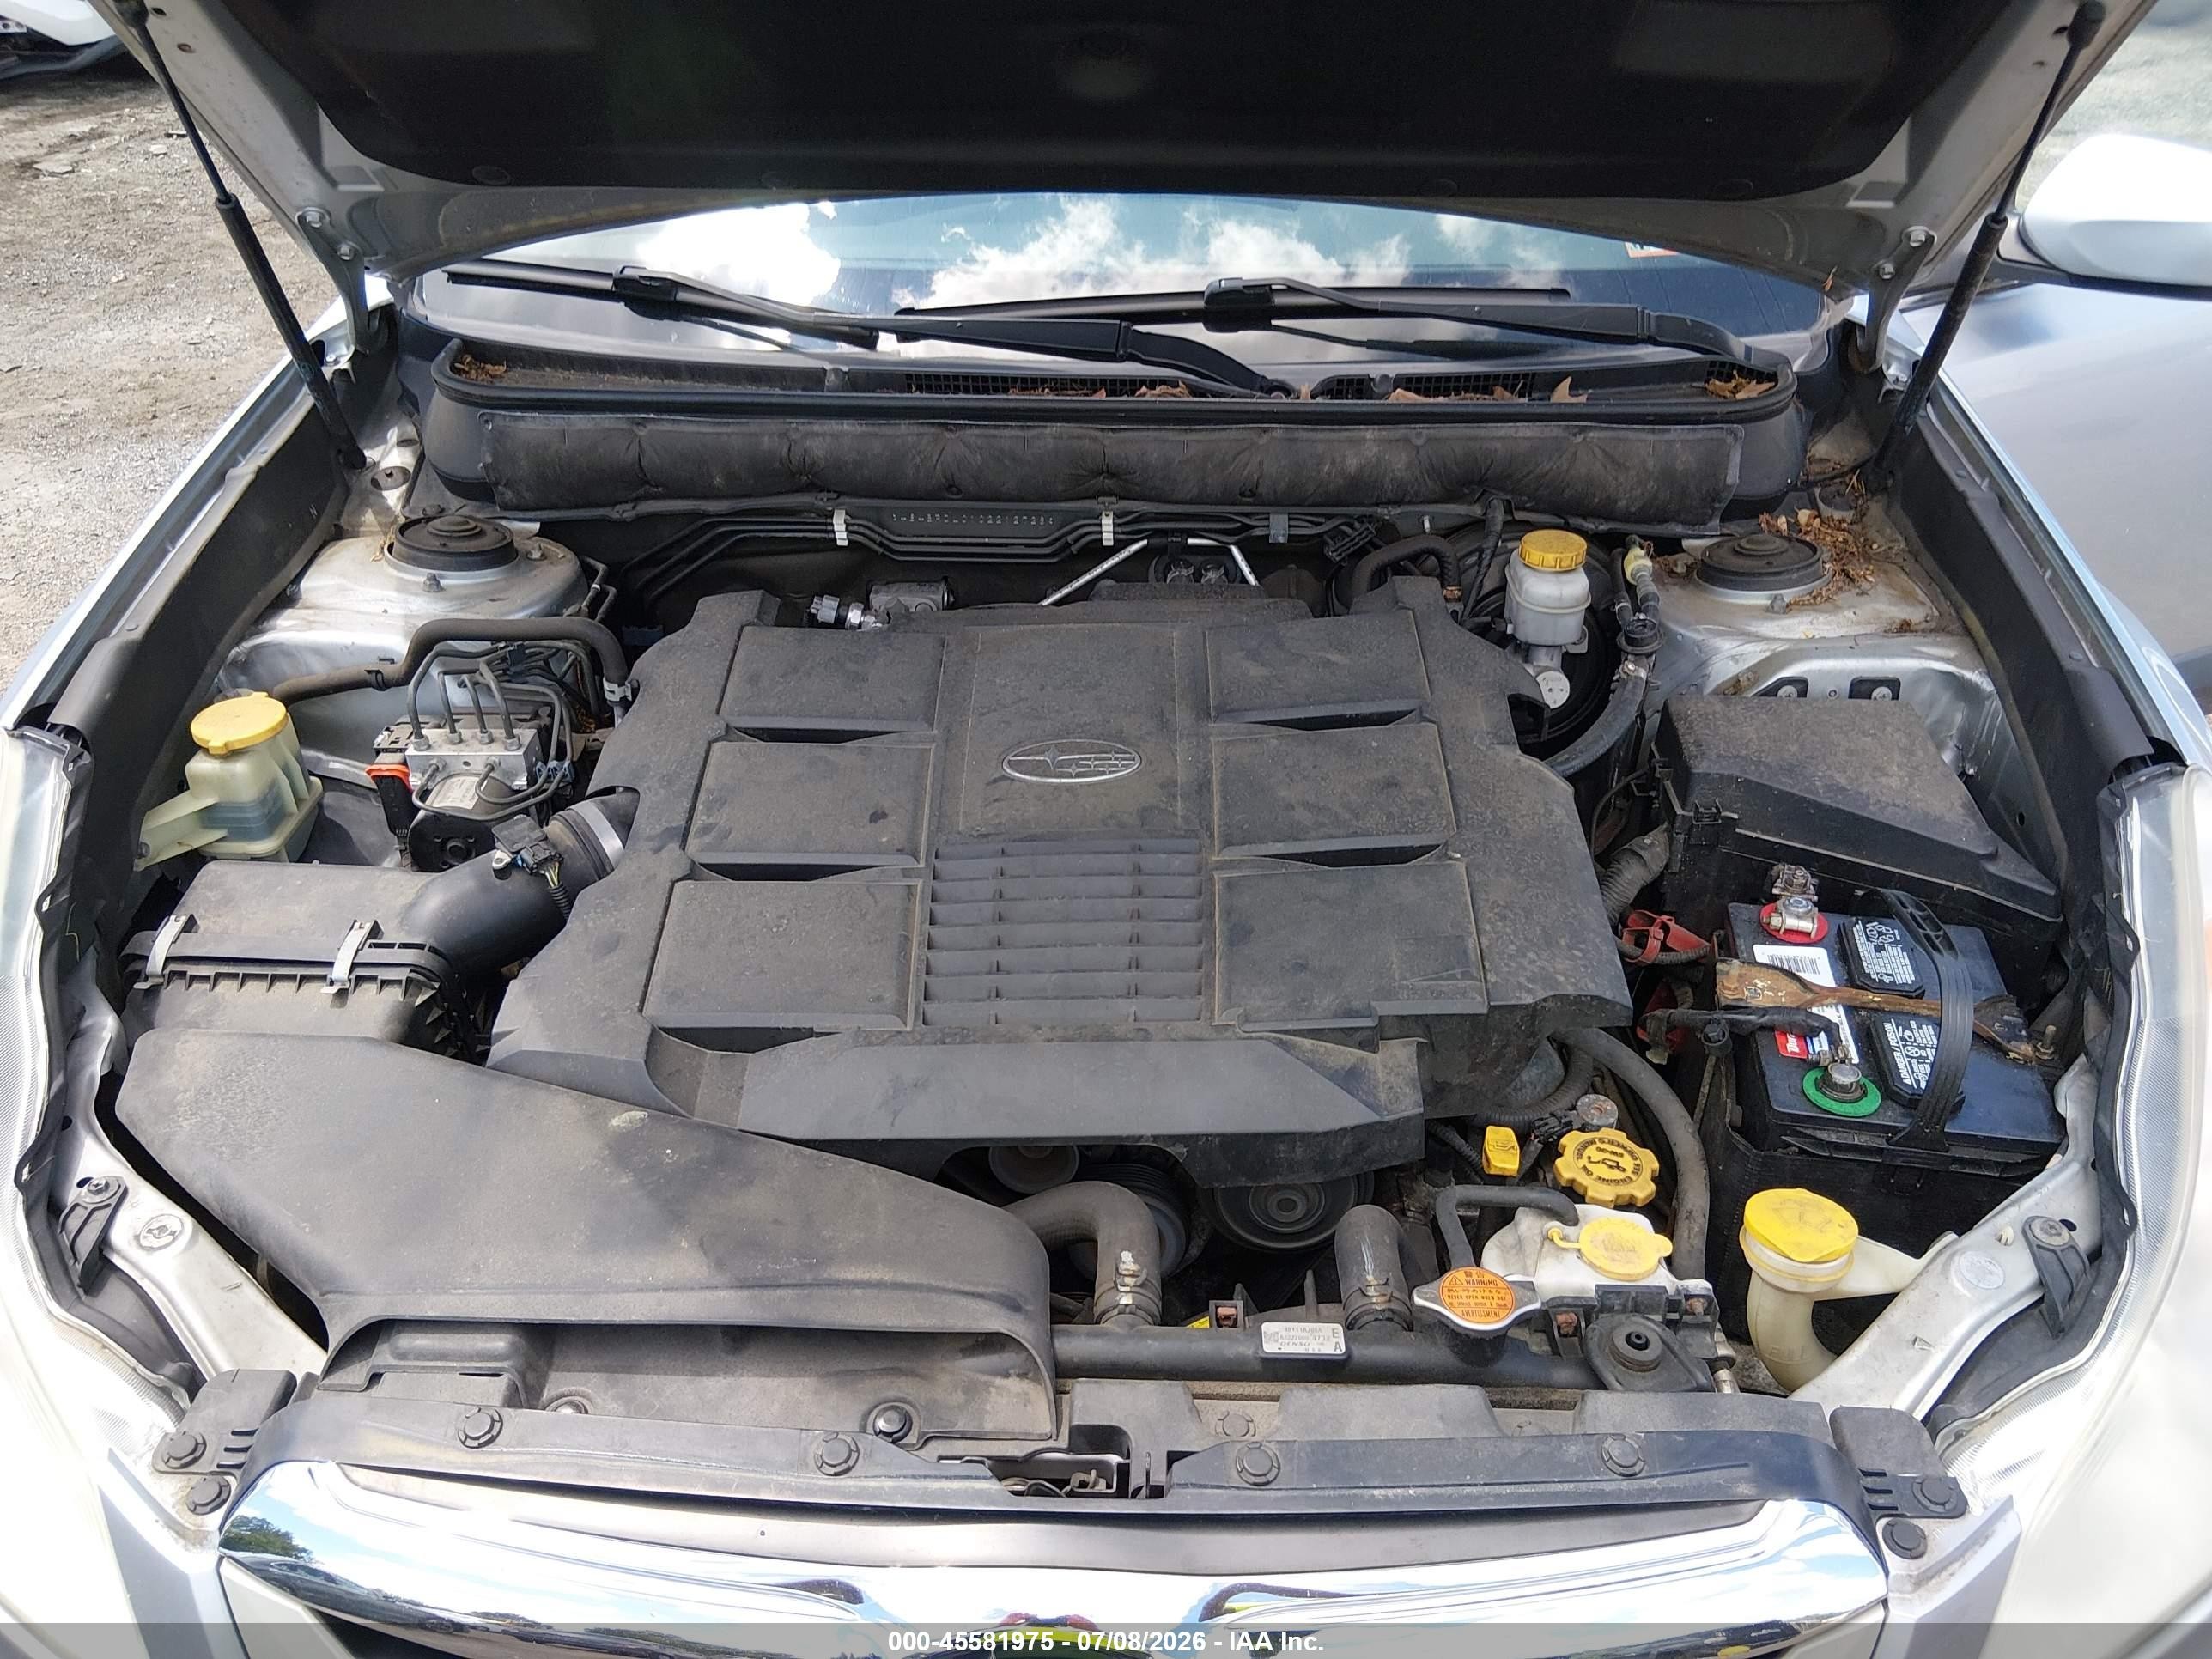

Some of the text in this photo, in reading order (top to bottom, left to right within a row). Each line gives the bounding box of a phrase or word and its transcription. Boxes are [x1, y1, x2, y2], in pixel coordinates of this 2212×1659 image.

[1884, 1023, 1898, 1046] POISON
[1894, 1053, 1910, 1079] DANGER
[1582, 1164, 1632, 1184] ENGINE OIL
[1332, 1328, 1340, 1339] E
[1334, 1341, 1342, 1352] A
